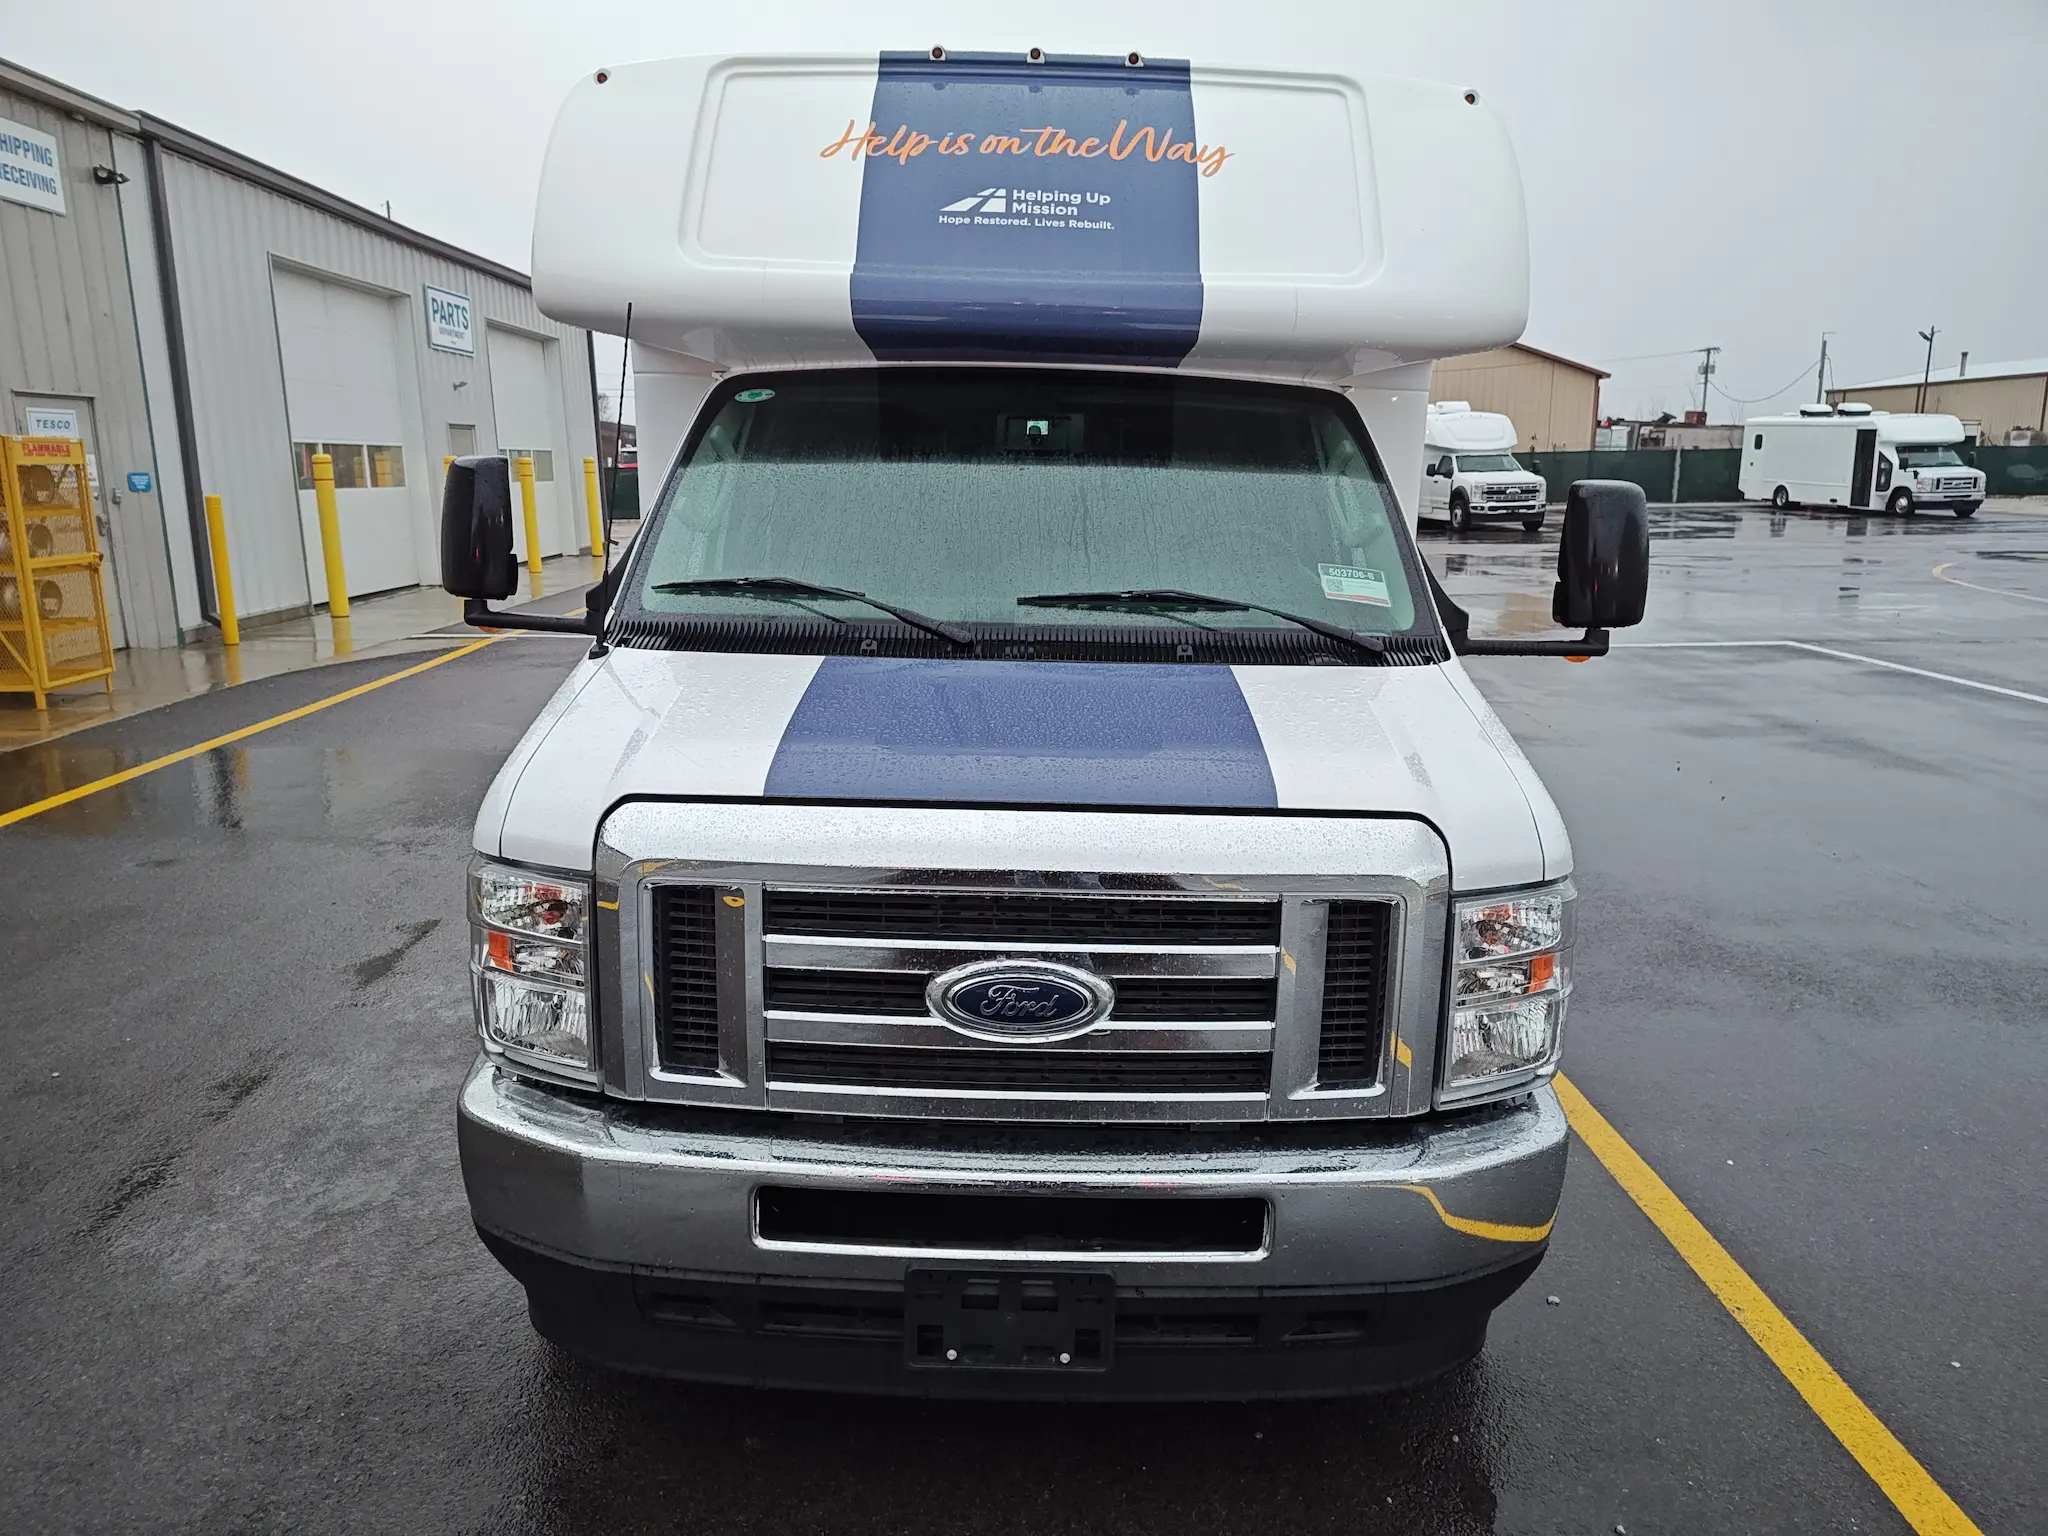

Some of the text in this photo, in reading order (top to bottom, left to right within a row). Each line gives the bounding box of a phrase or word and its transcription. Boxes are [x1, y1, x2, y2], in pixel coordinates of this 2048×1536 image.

[820, 119, 1236, 177] Help is on the Way
[1012, 189, 1112, 206] Helping Up
[1012, 202, 1078, 216] Mission
[938, 215, 1116, 231] Hope Restored. Lives Rebuilt.
[431, 297, 469, 330] PARTS
[36, 419, 71, 429] TESCO
[21, 443, 71, 454] FLAMMABLE
[979, 984, 1060, 1017] Ford
